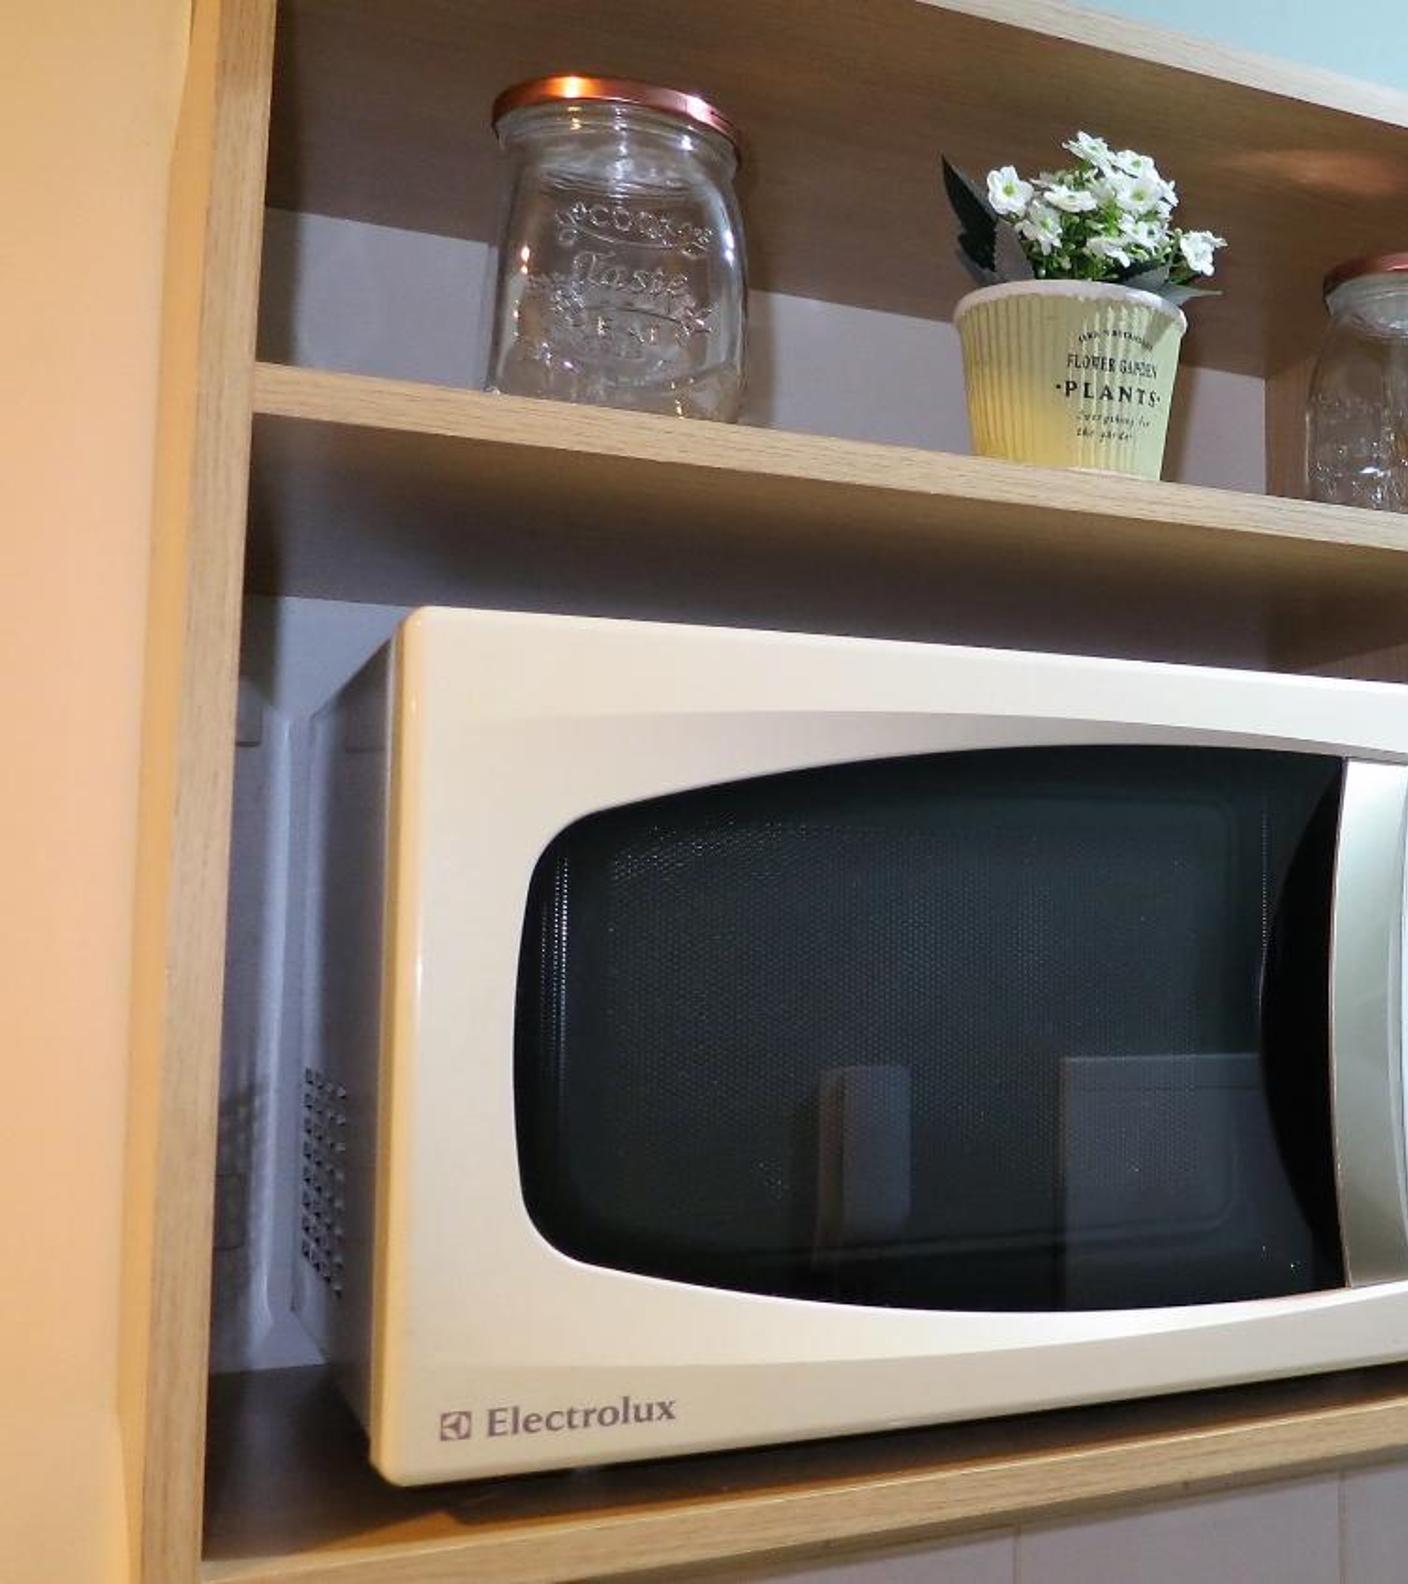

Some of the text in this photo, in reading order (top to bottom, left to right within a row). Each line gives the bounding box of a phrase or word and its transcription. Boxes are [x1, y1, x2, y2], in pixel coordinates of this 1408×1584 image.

[1067, 354, 1158, 379] FLOWER GARDEN
[486, 1395, 677, 1437] Electrolux
